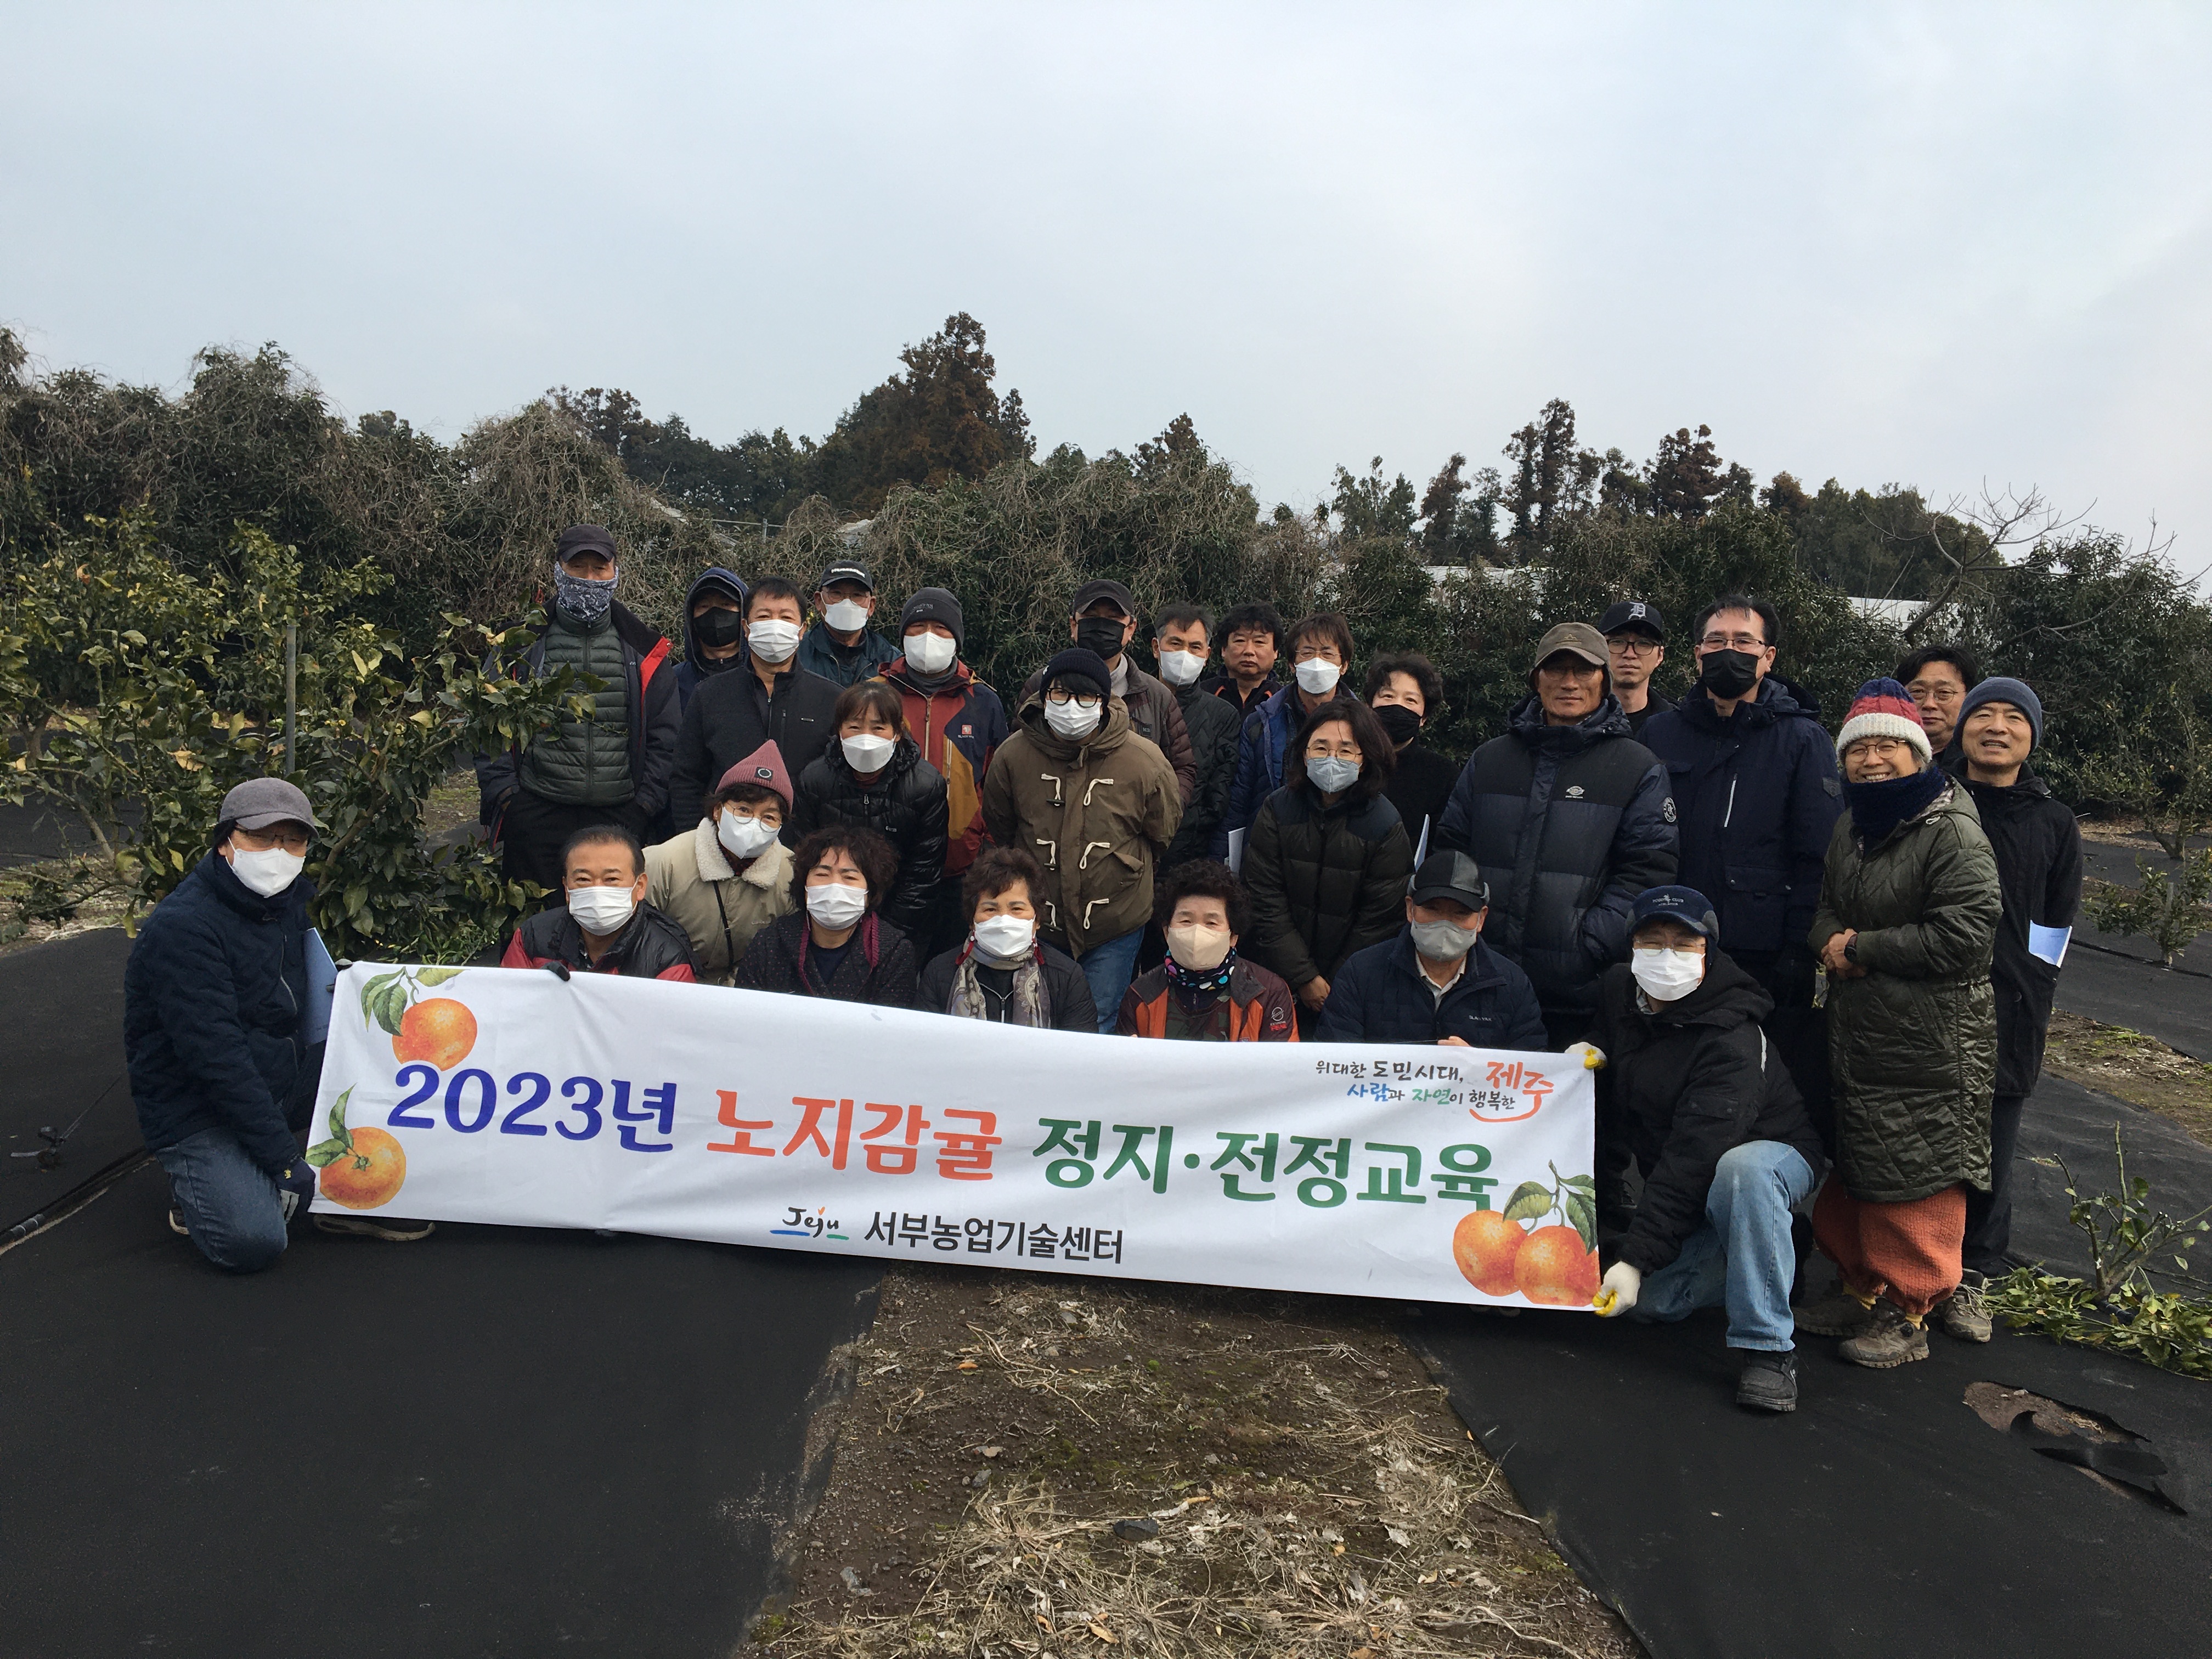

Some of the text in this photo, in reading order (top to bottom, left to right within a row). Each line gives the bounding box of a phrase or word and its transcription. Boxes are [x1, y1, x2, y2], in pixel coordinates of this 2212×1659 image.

[1628, 601, 1647, 620] D
[1316, 1060, 1464, 1084] 위대한 도민시대,
[1346, 1061, 1554, 1111] 사람과 자연이 행복한 제주
[387, 1064, 1499, 1209] 2023년 노지감귤 정지·전정교육
[782, 1206, 1122, 1264] Jeju 서부농업기술센터
